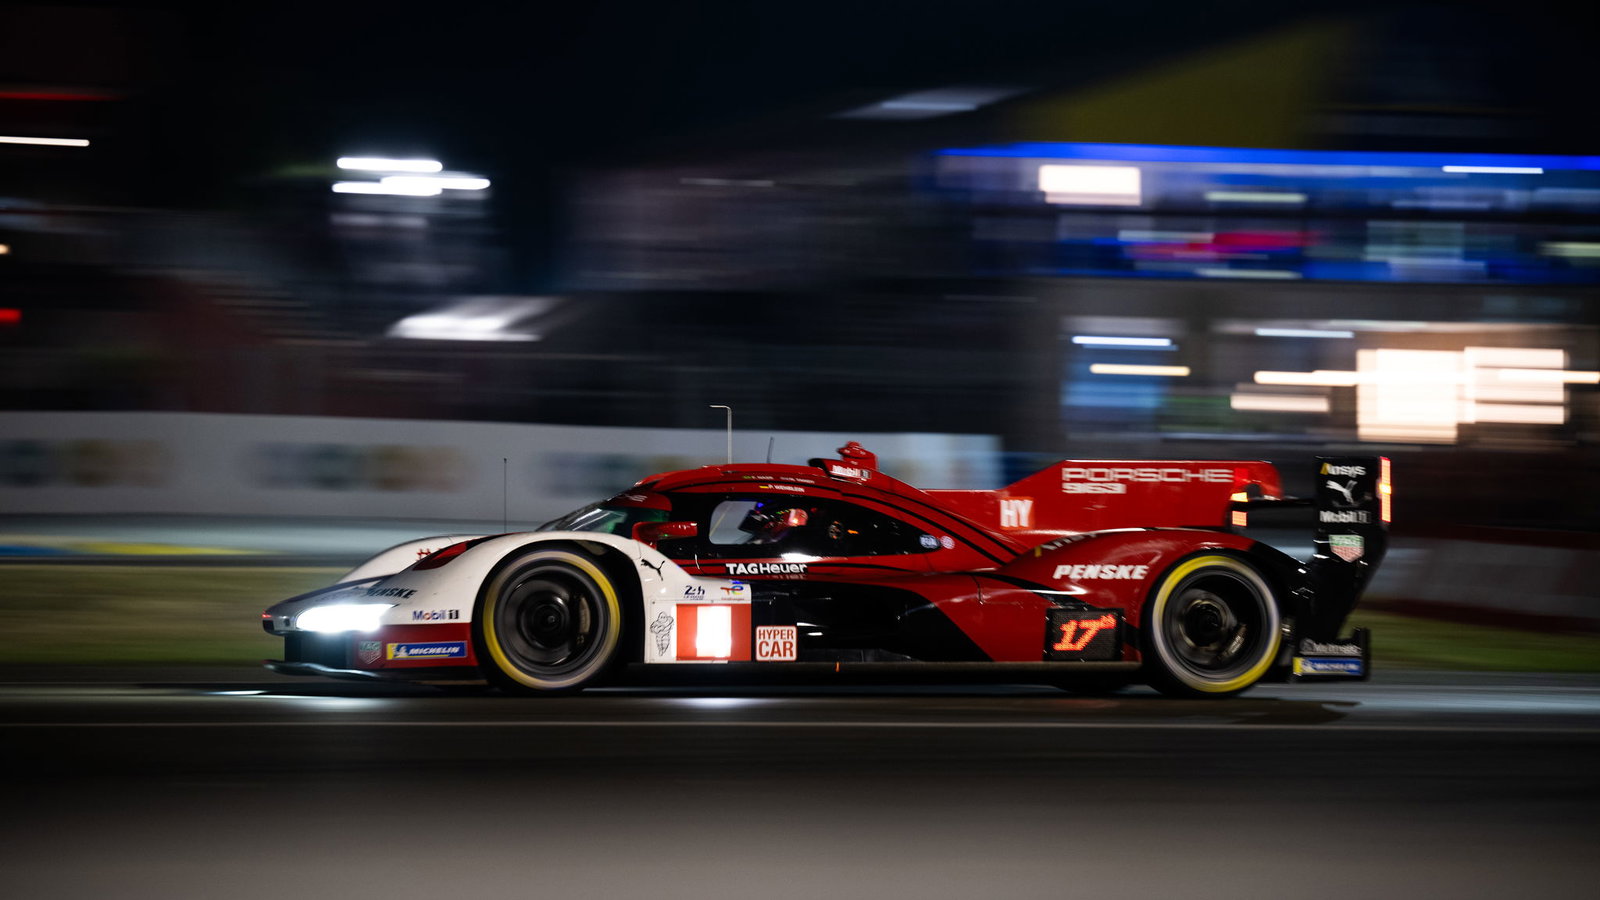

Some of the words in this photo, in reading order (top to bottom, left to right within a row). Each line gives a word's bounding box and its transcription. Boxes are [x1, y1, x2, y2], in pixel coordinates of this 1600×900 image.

[1062, 468, 1234, 482] PORSCHE
[1062, 483, 1126, 494] 963
[1000, 500, 1033, 527] HY
[1320, 511, 1357, 523] Mobil
[1052, 565, 1150, 580] PENSKE
[412, 610, 447, 620] Mobil
[758, 629, 794, 640] HYPER
[409, 646, 460, 655] MICHELIN
[758, 641, 794, 657] CAR
